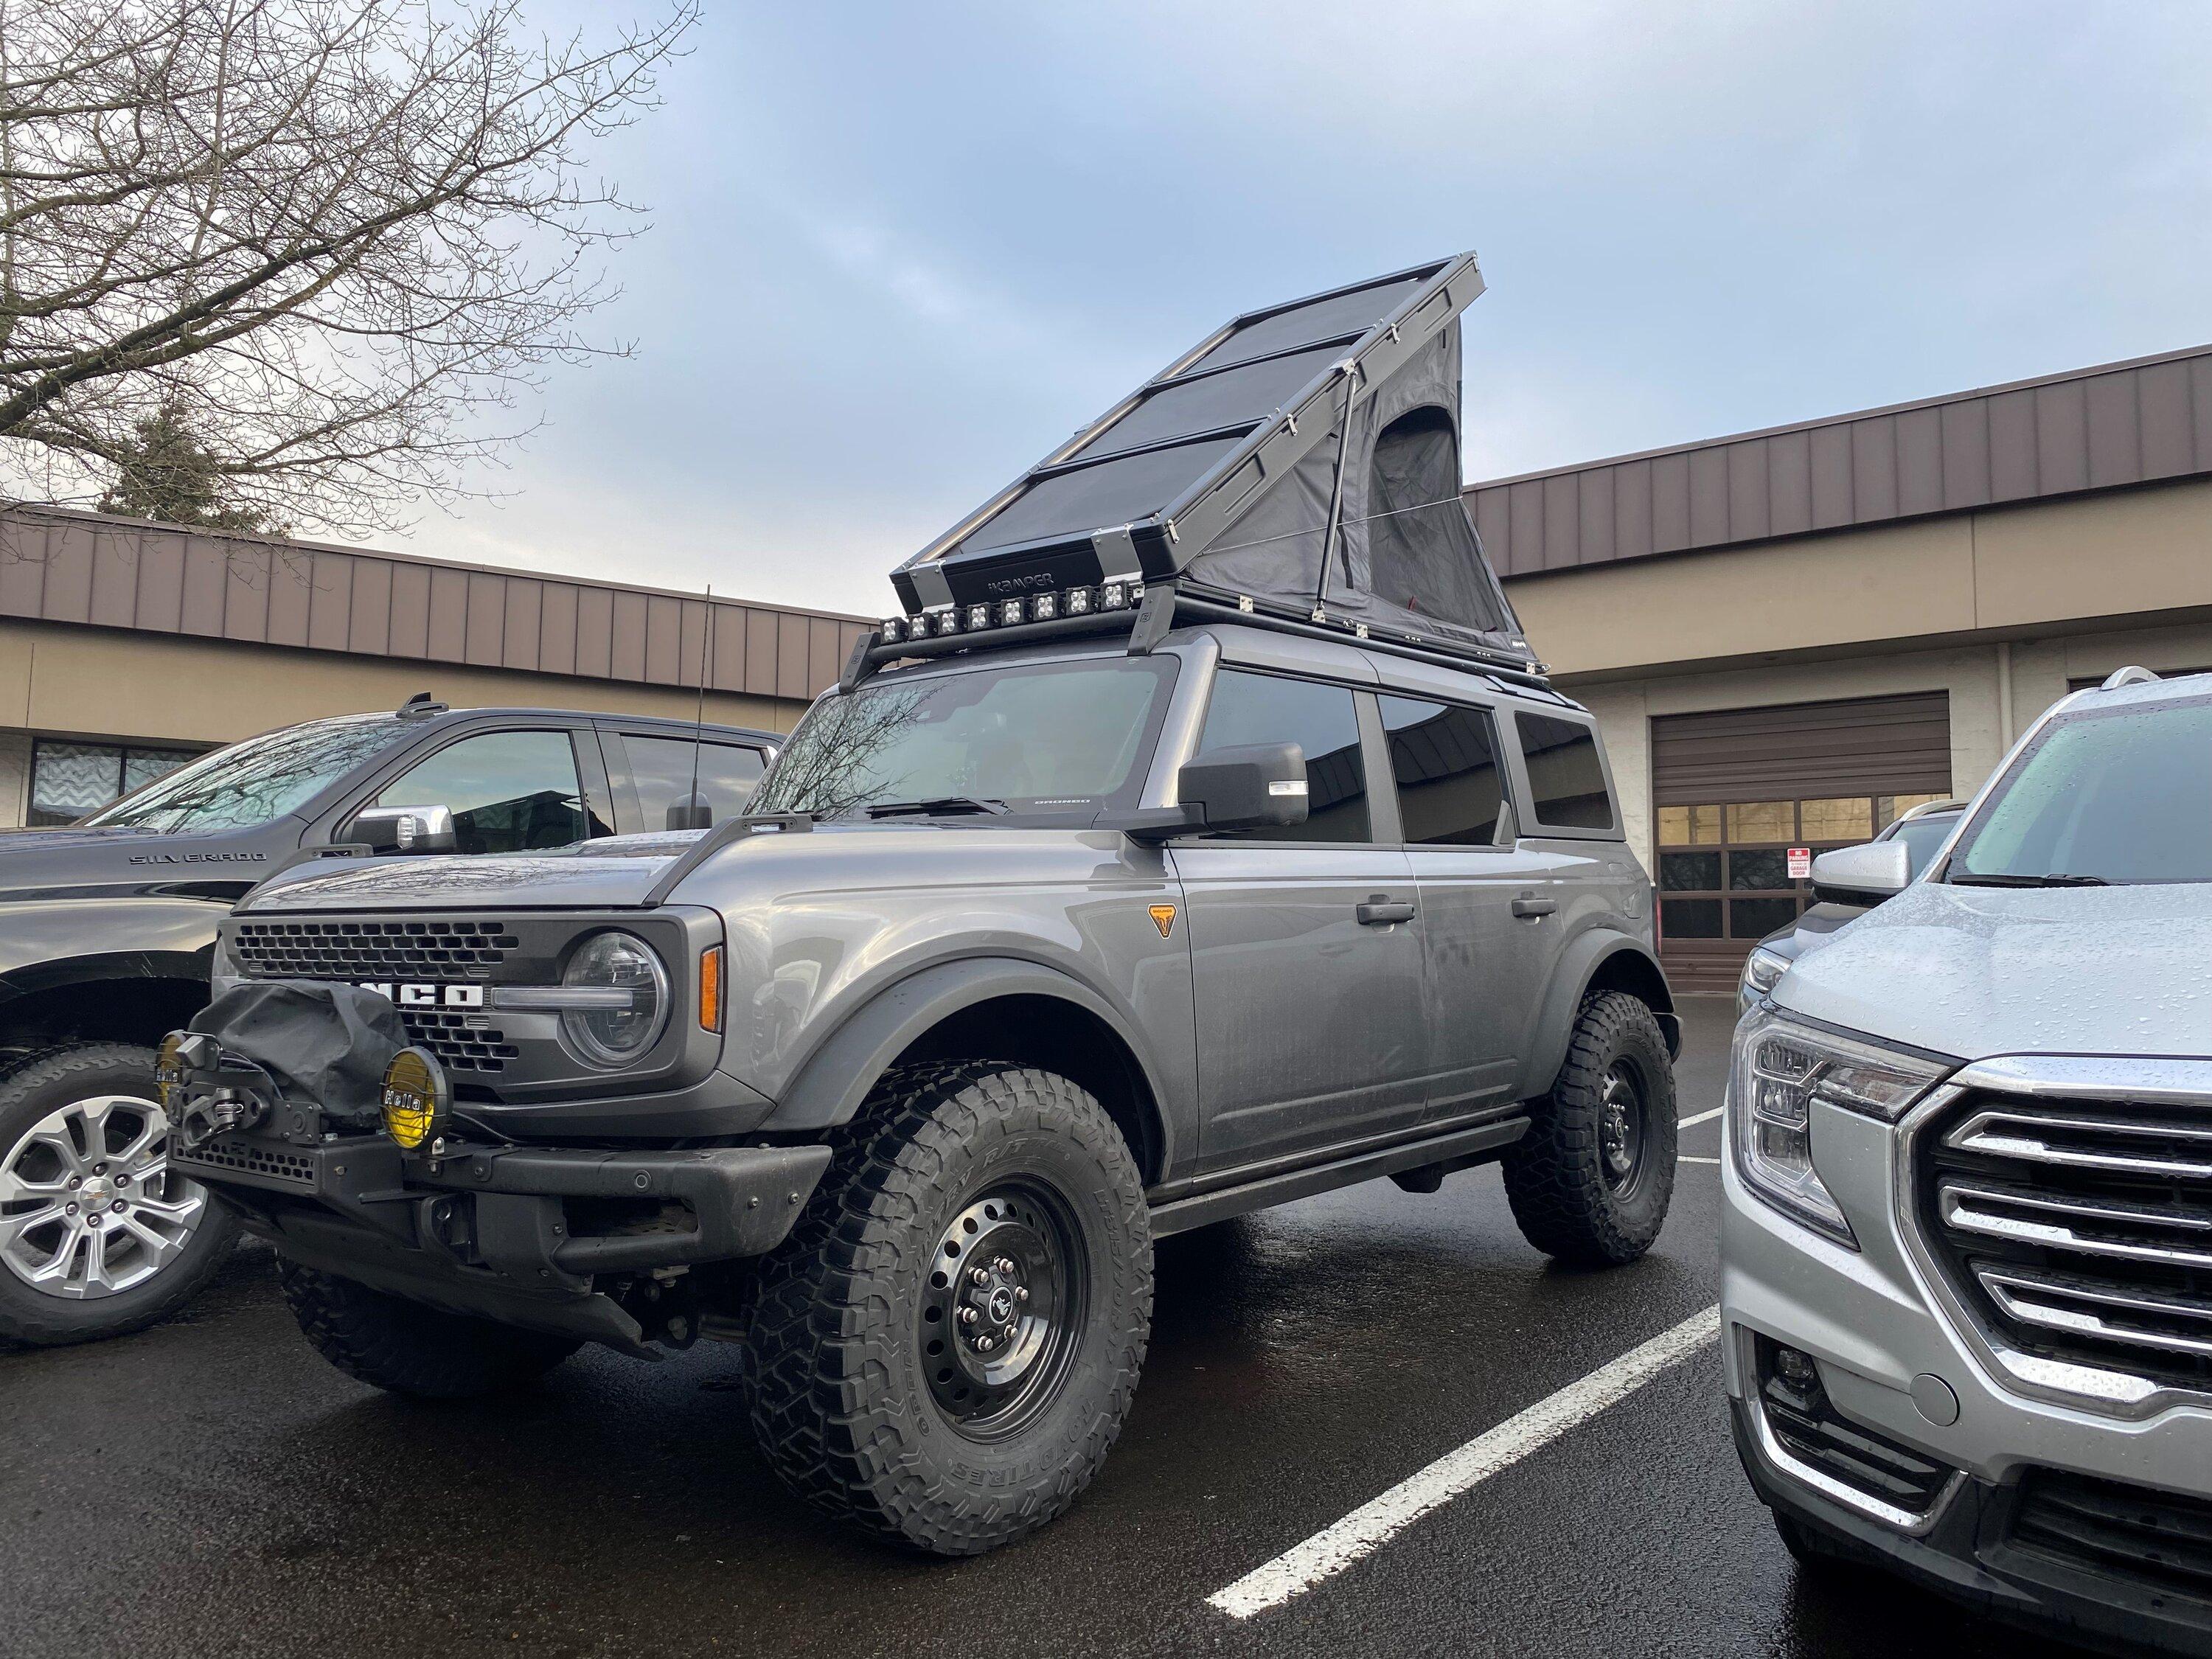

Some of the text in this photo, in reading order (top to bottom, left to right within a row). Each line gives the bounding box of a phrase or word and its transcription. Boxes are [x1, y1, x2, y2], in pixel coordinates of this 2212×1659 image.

[129, 852, 268, 865] SILVERADO
[384, 1090, 421, 1111] Hella
[981, 1137, 1029, 1170] R/T
[1038, 1399, 1095, 1471] TOYO
[950, 1458, 1036, 1487] TIRES
